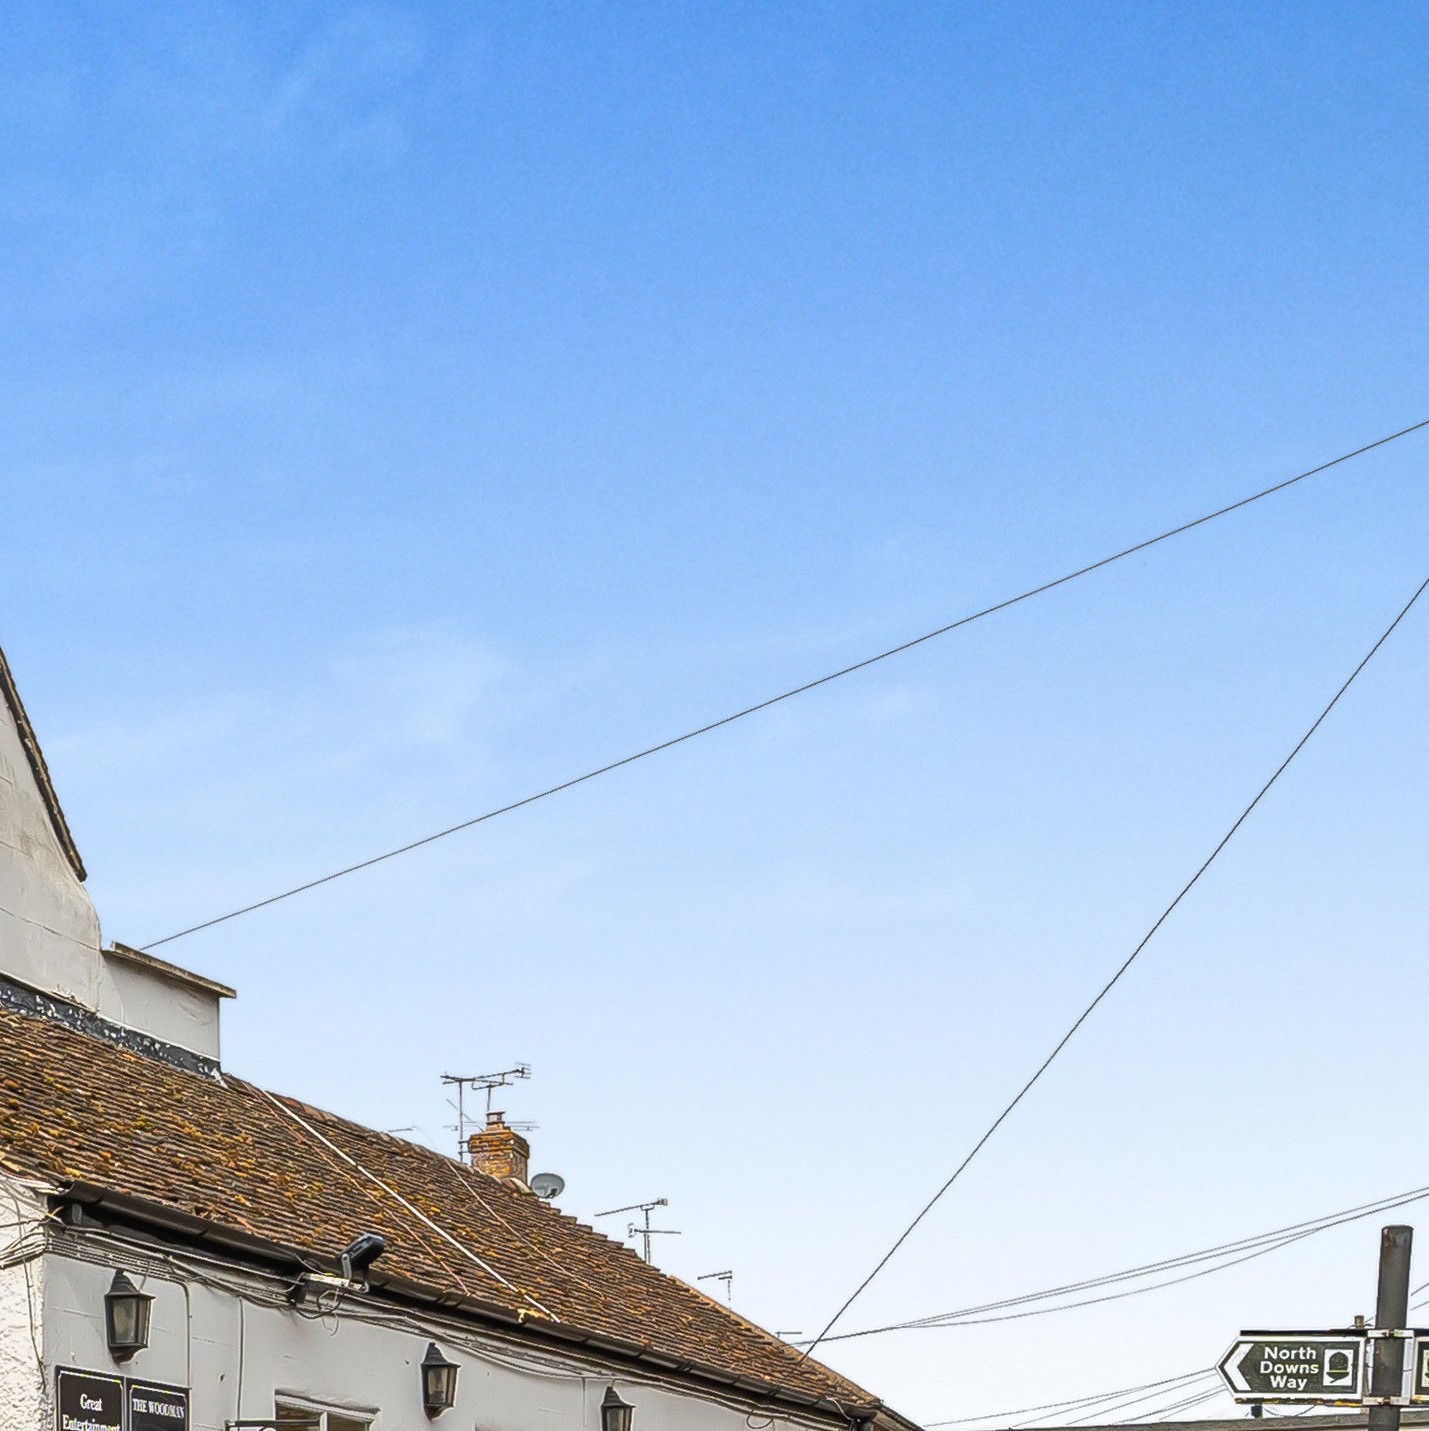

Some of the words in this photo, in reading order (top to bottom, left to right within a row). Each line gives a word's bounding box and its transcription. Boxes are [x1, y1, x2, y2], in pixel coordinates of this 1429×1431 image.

[1264, 1347, 1316, 1360] North
[1260, 1361, 1319, 1374] Downs
[1270, 1376, 1307, 1390] Way
[80, 1393, 103, 1411] Great
[132, 1398, 147, 1413] THE
[148, 1400, 184, 1418] WOODMAN
